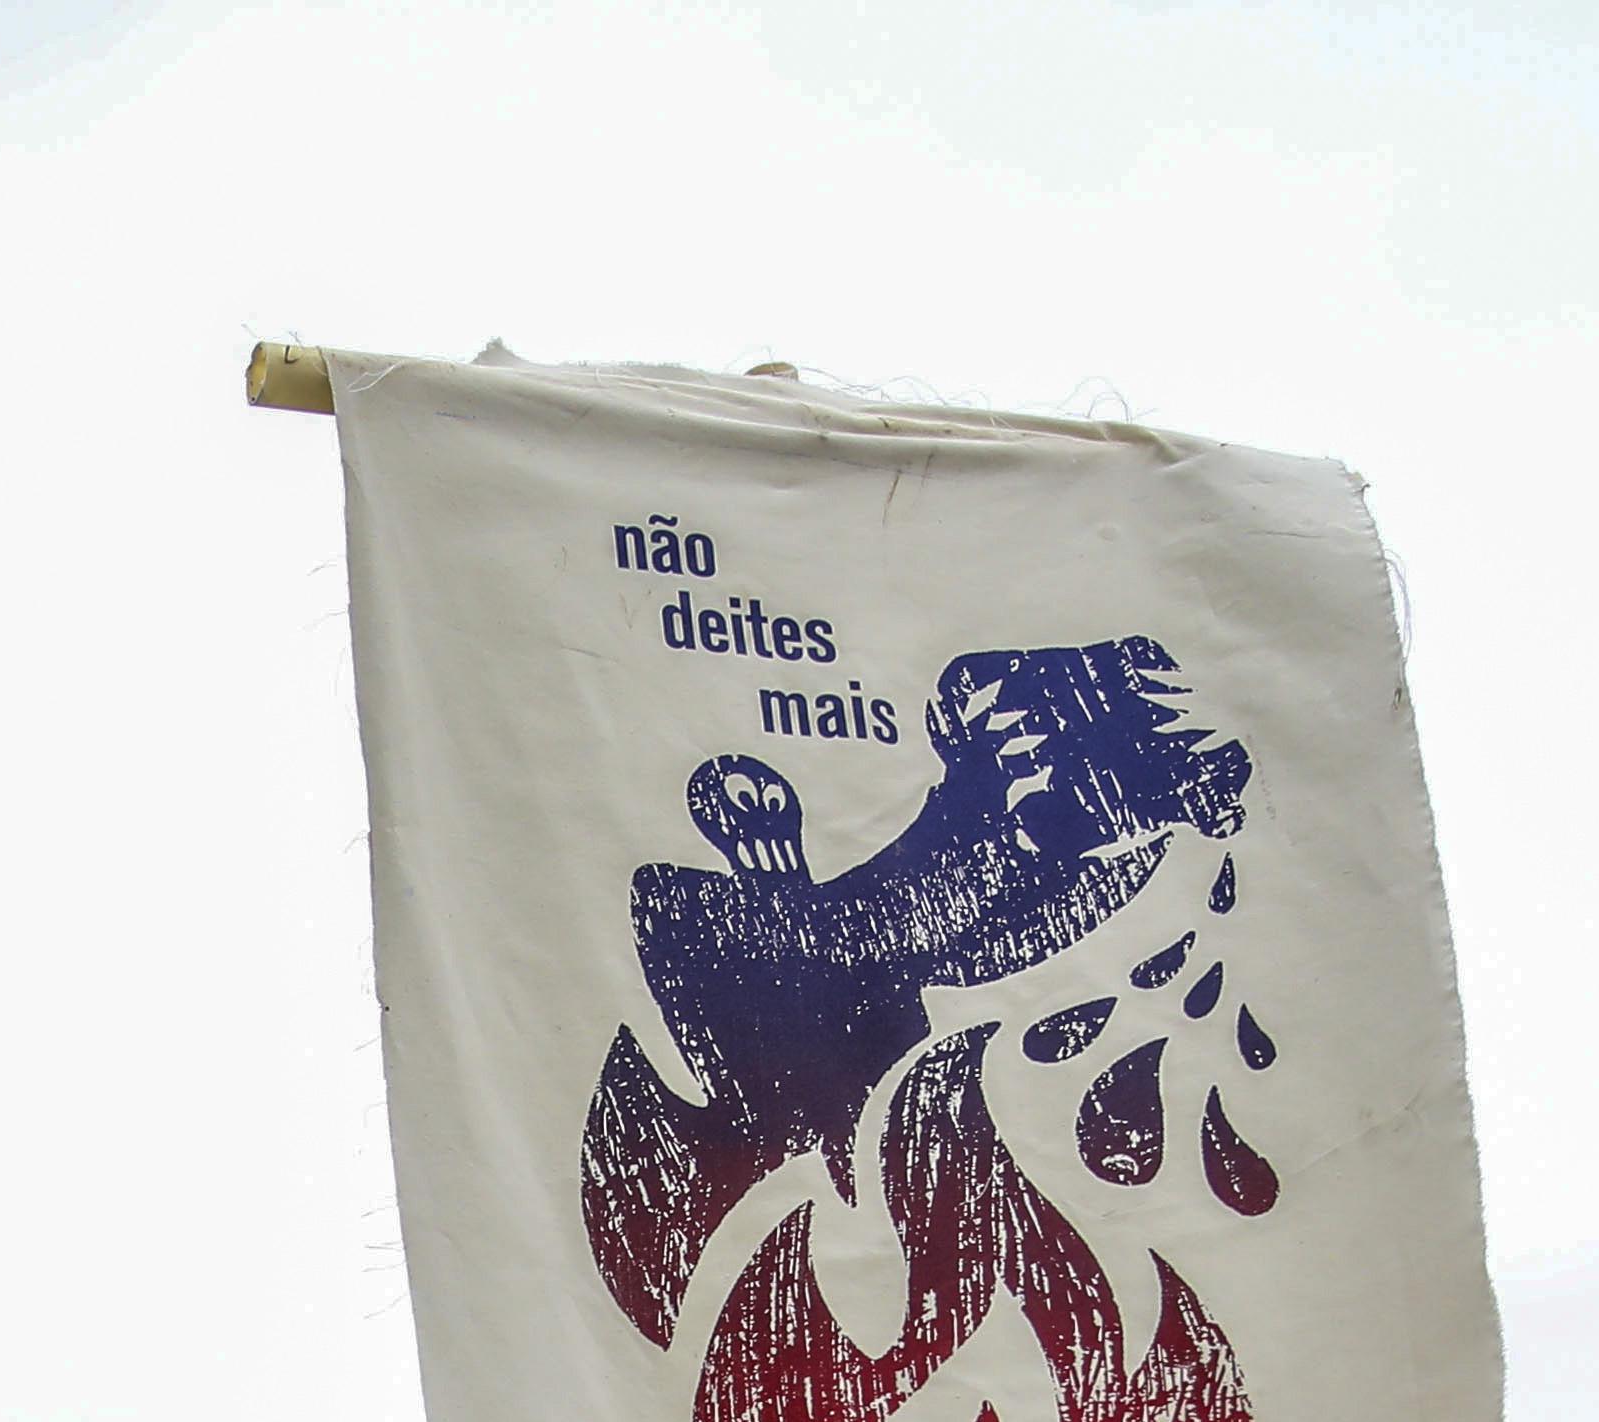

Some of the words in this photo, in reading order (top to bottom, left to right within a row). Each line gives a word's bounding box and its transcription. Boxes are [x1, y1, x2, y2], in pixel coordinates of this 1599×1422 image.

[614, 514, 716, 578] não
[662, 590, 837, 663] deites
[759, 680, 899, 745] mais
